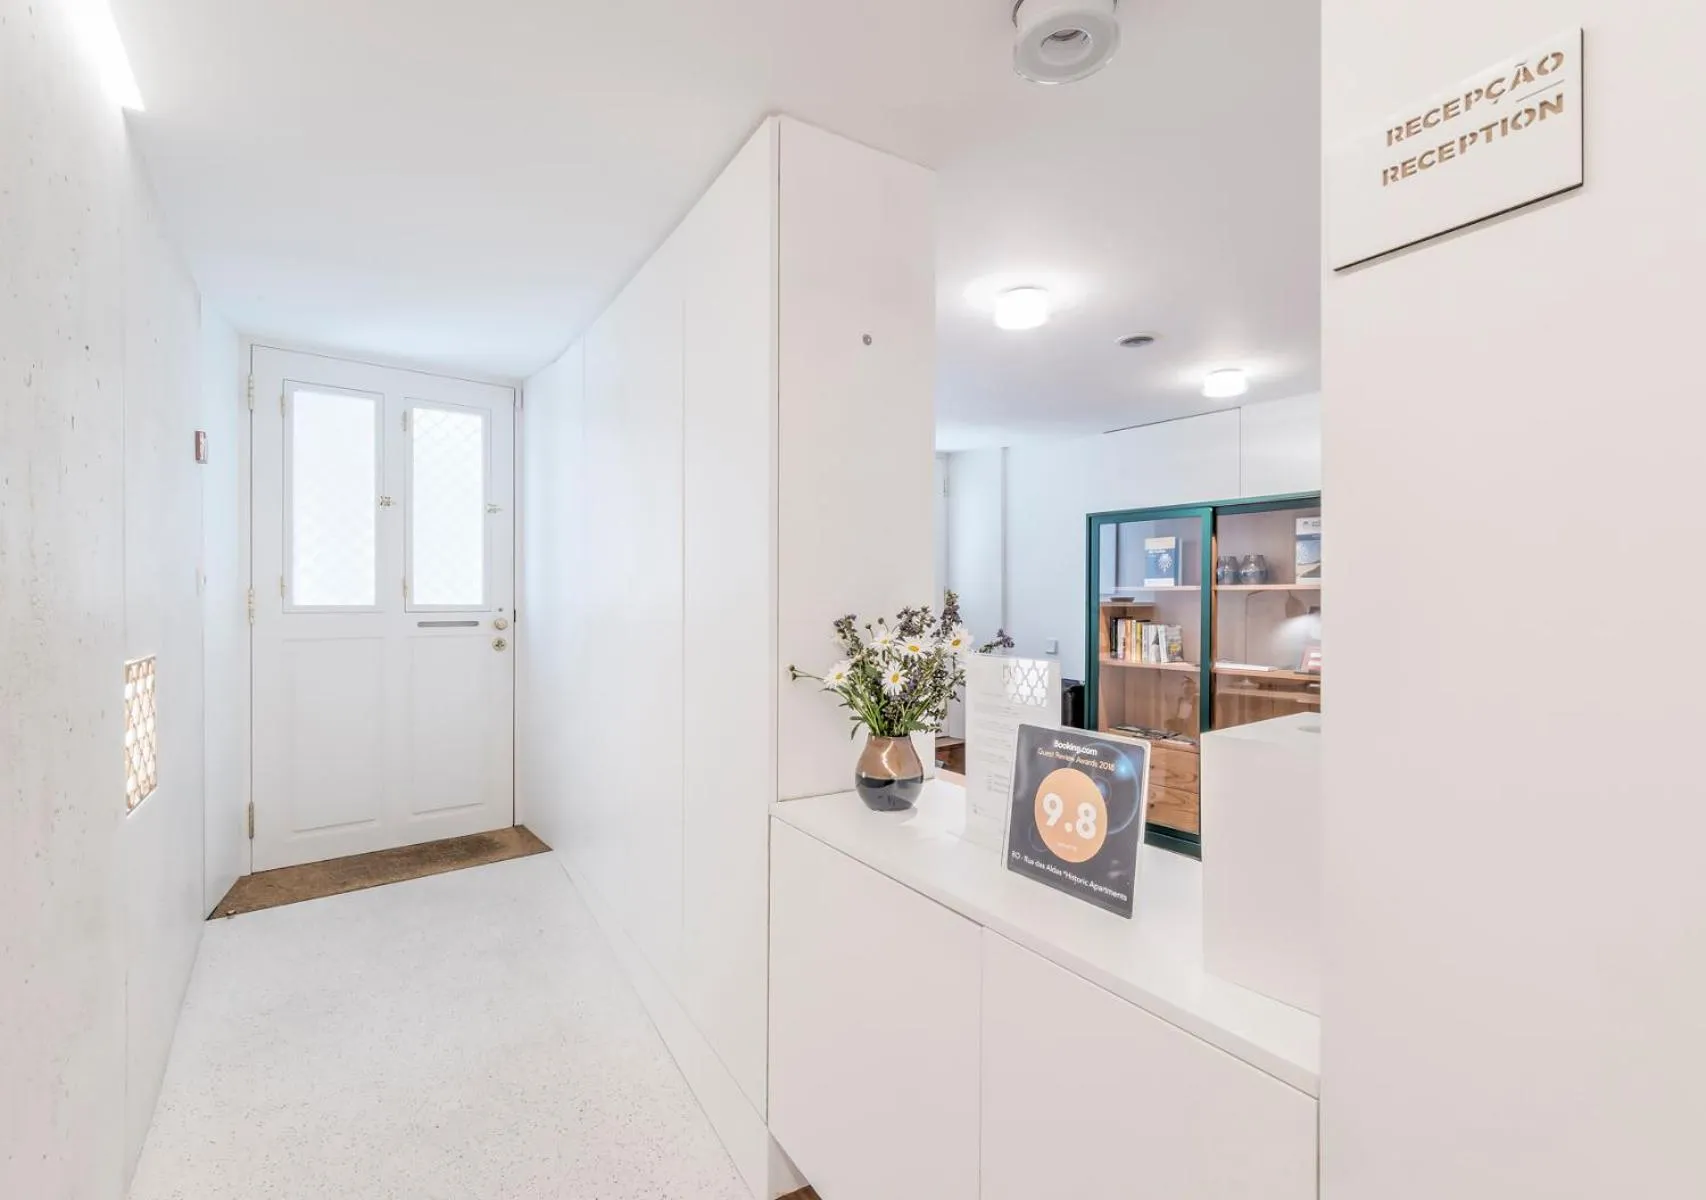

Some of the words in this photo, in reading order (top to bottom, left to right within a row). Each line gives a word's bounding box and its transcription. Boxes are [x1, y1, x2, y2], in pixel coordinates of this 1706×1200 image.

[1386, 51, 1565, 147] RECEPÇÃO
[1381, 92, 1564, 187] RECEPTION
[1053, 739, 1098, 756] Booking.com
[1043, 792, 1097, 840] 9.8
